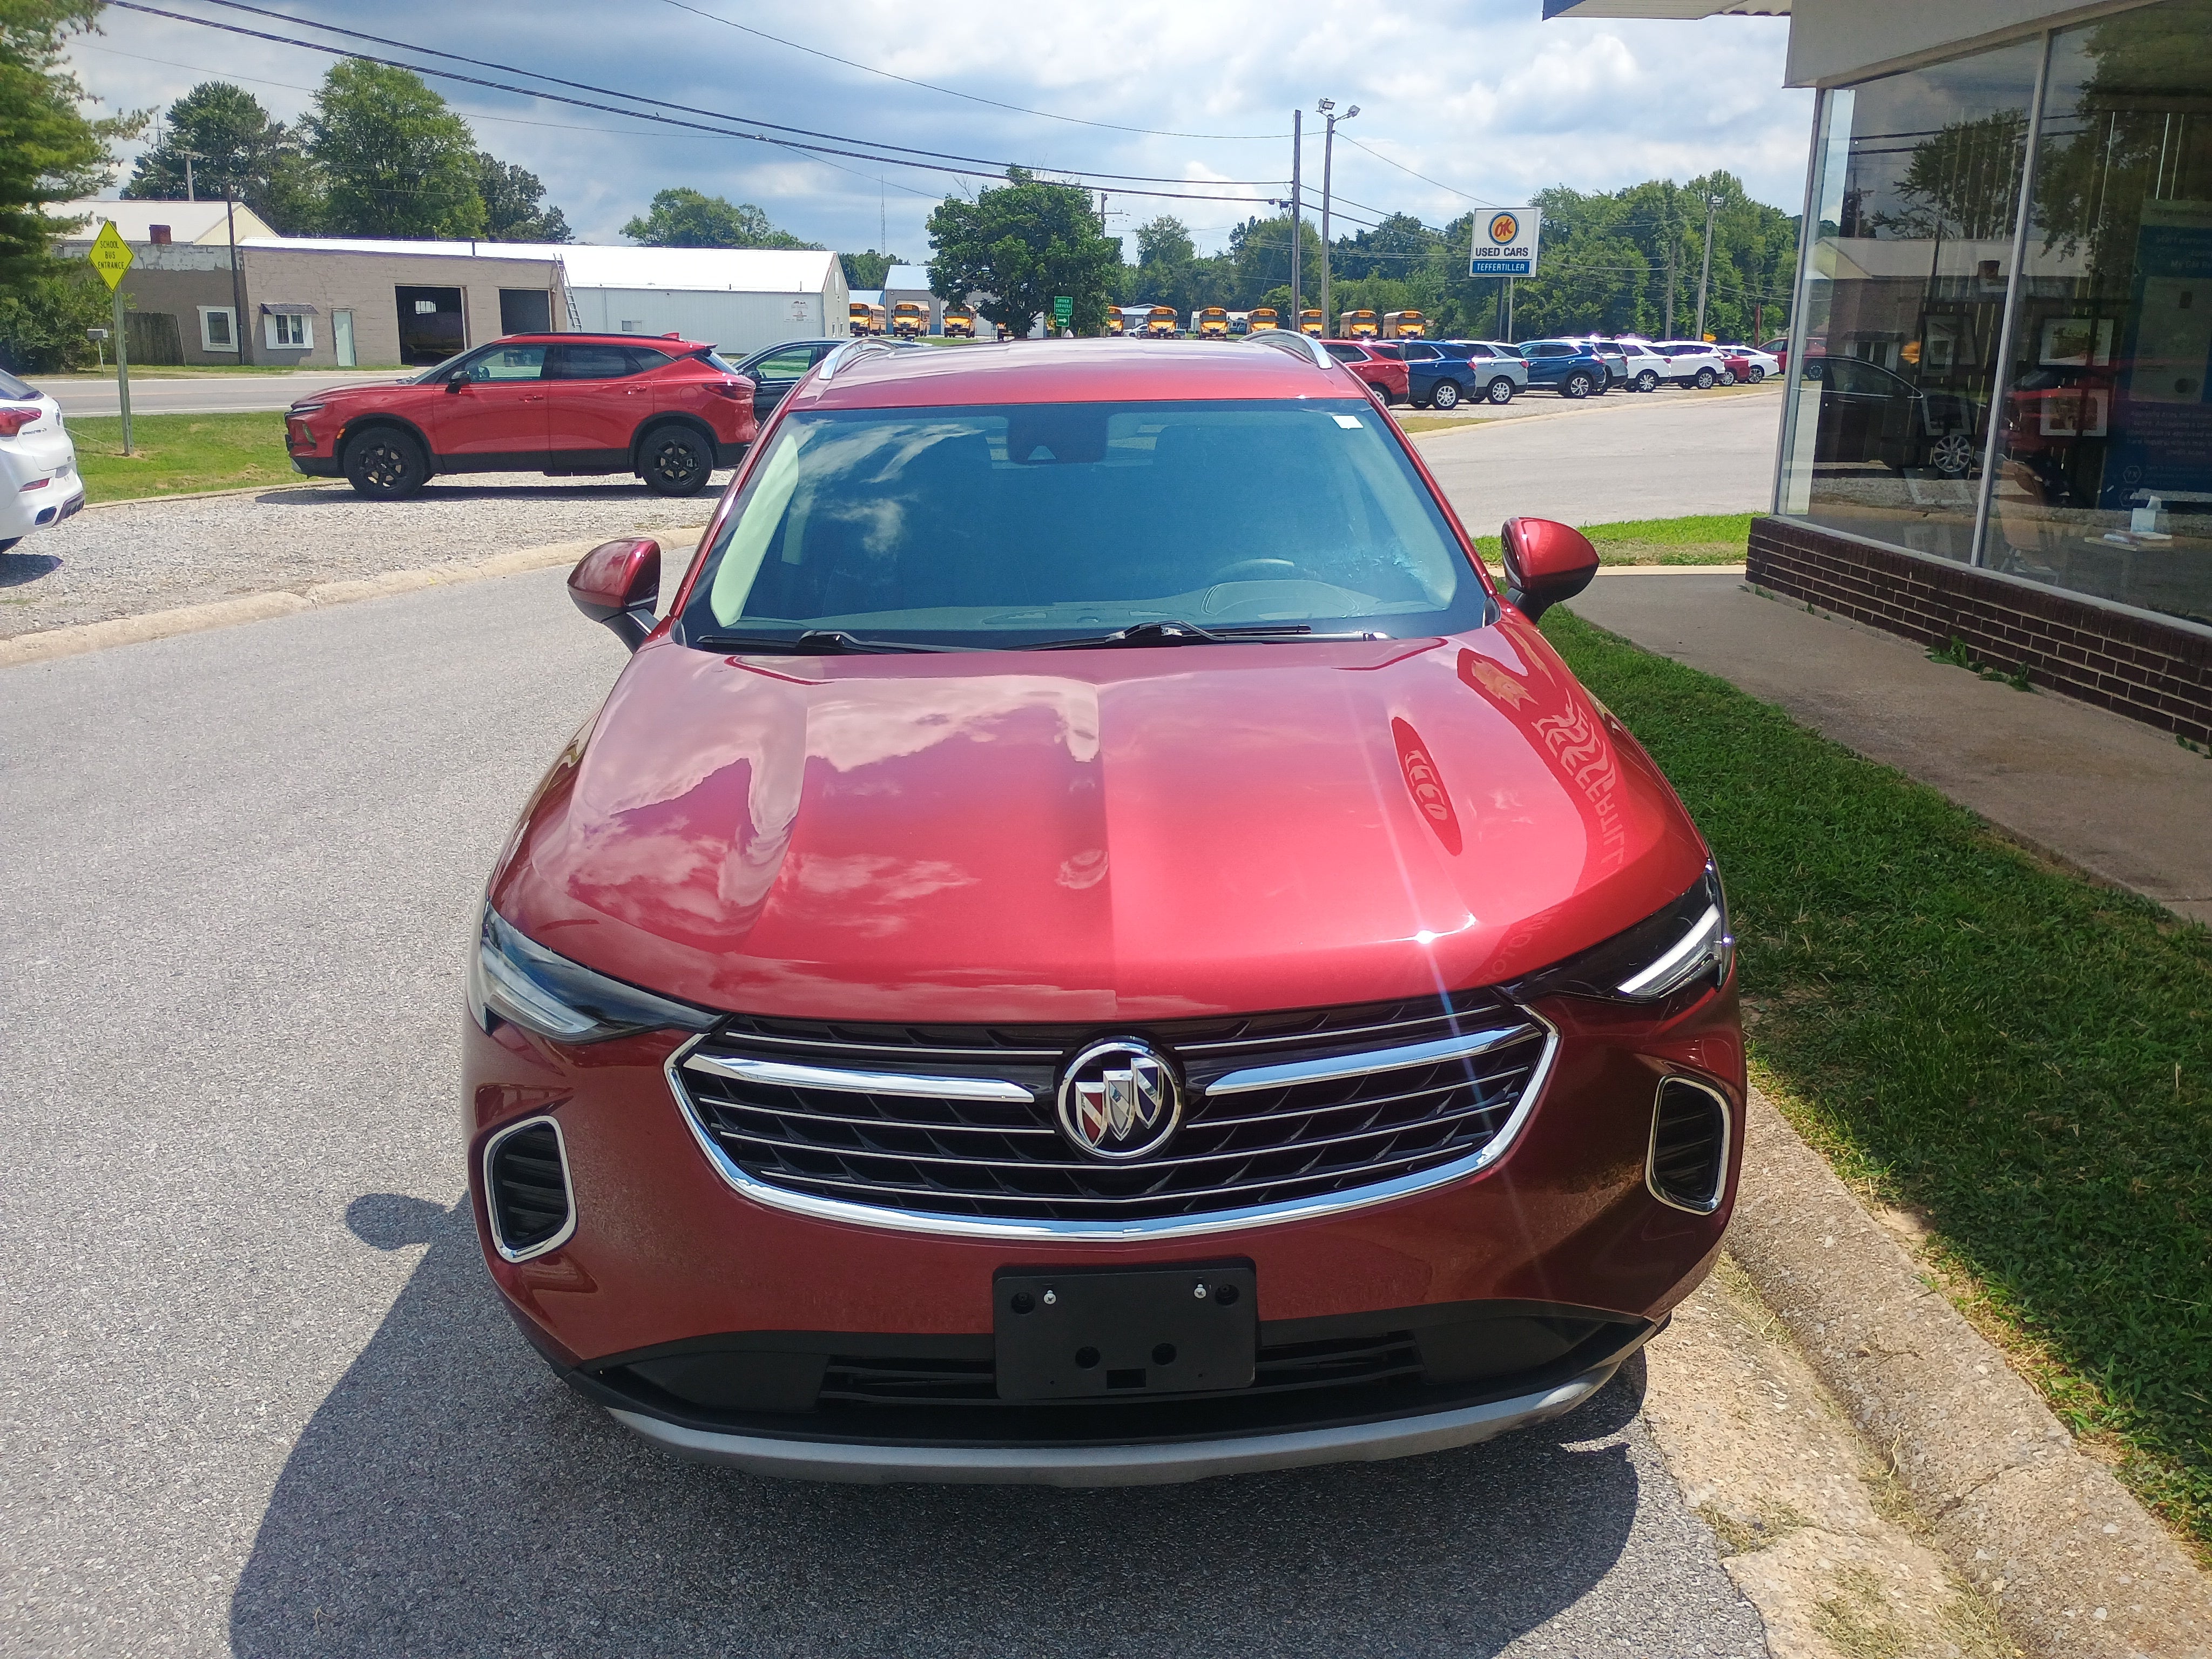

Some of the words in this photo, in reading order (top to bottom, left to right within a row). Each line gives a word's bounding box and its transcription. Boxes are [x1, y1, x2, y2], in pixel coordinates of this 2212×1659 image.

[1494, 219, 1513, 237] OK
[100, 240, 119, 249] SCHOOL
[105, 251, 116, 259] BUS
[1475, 247, 1500, 257] USED
[1503, 247, 1529, 257] CARS
[98, 261, 125, 269] ENTRANCE
[1477, 263, 1525, 271] TEFFERTILLER
